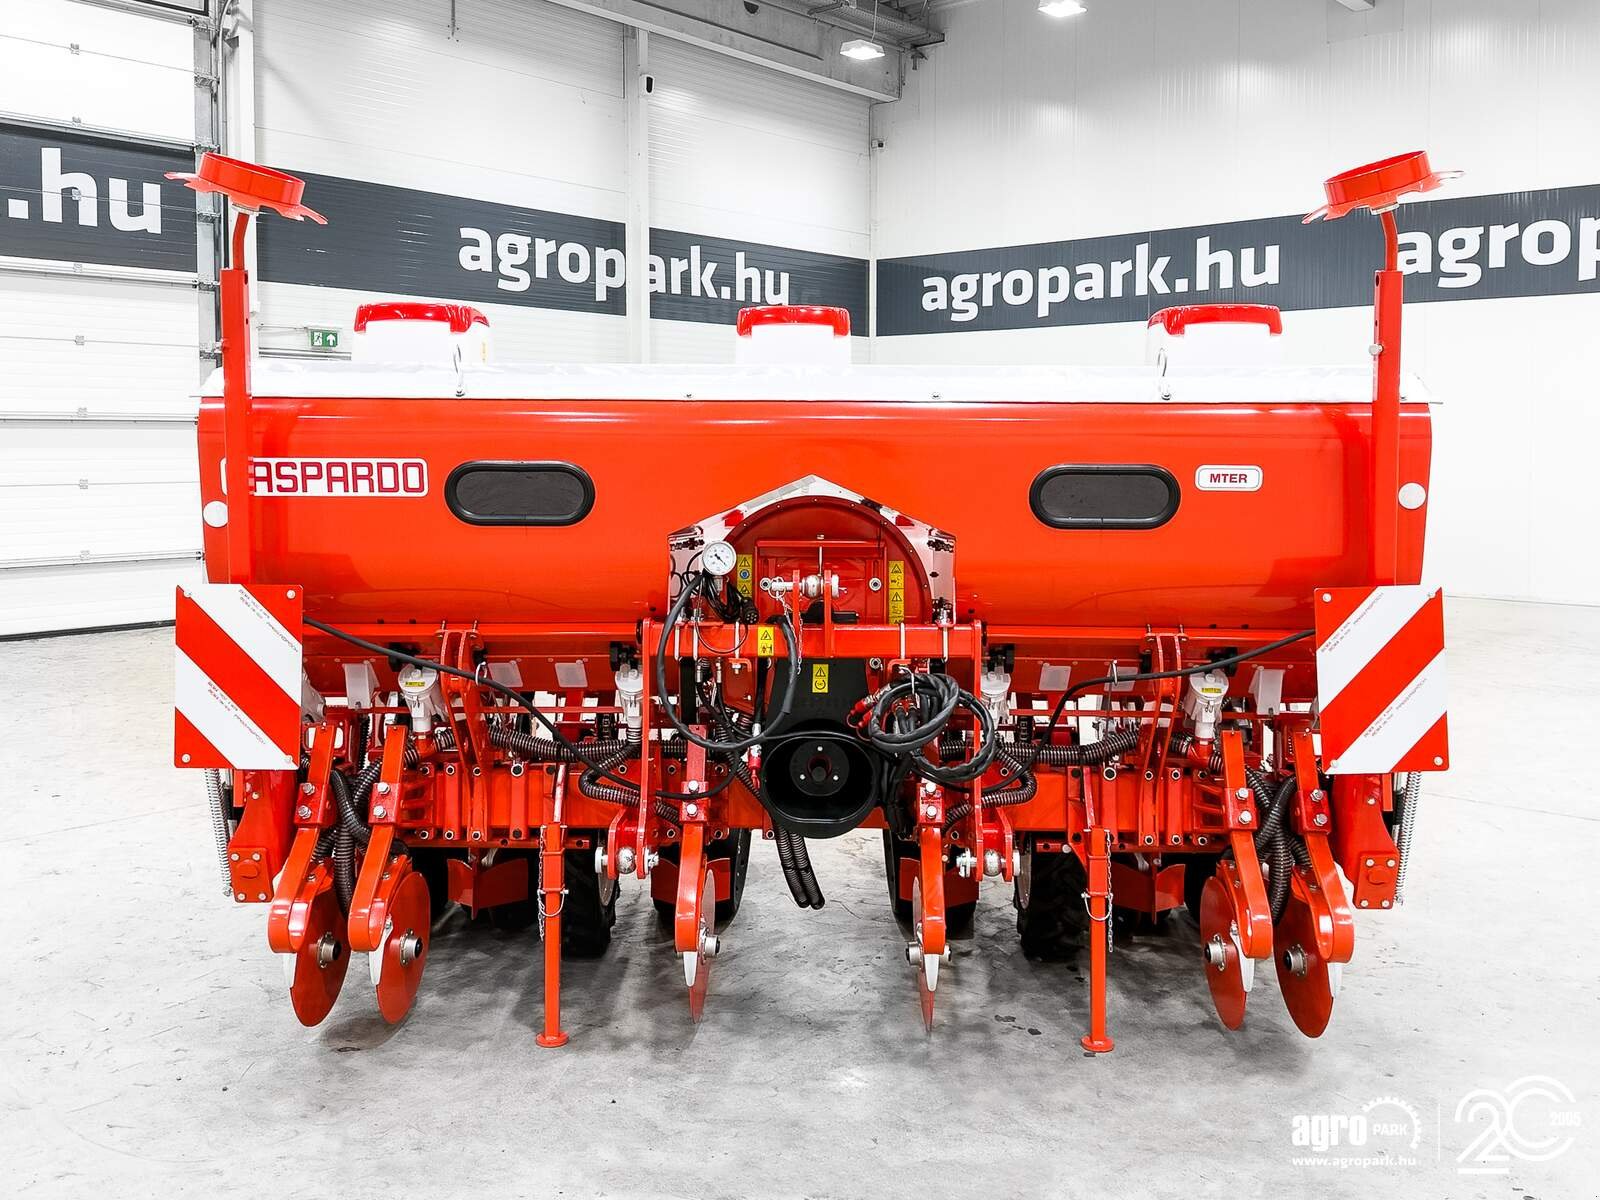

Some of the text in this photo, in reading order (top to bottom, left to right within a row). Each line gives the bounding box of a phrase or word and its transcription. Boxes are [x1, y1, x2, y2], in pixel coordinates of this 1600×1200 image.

[8, 147, 161, 234] .hu
[458, 226, 790, 305] agropark.hu
[921, 236, 1280, 322] agropark.hu
[253, 461, 425, 493] ASPARDO
[1209, 473, 1248, 483] MTER
